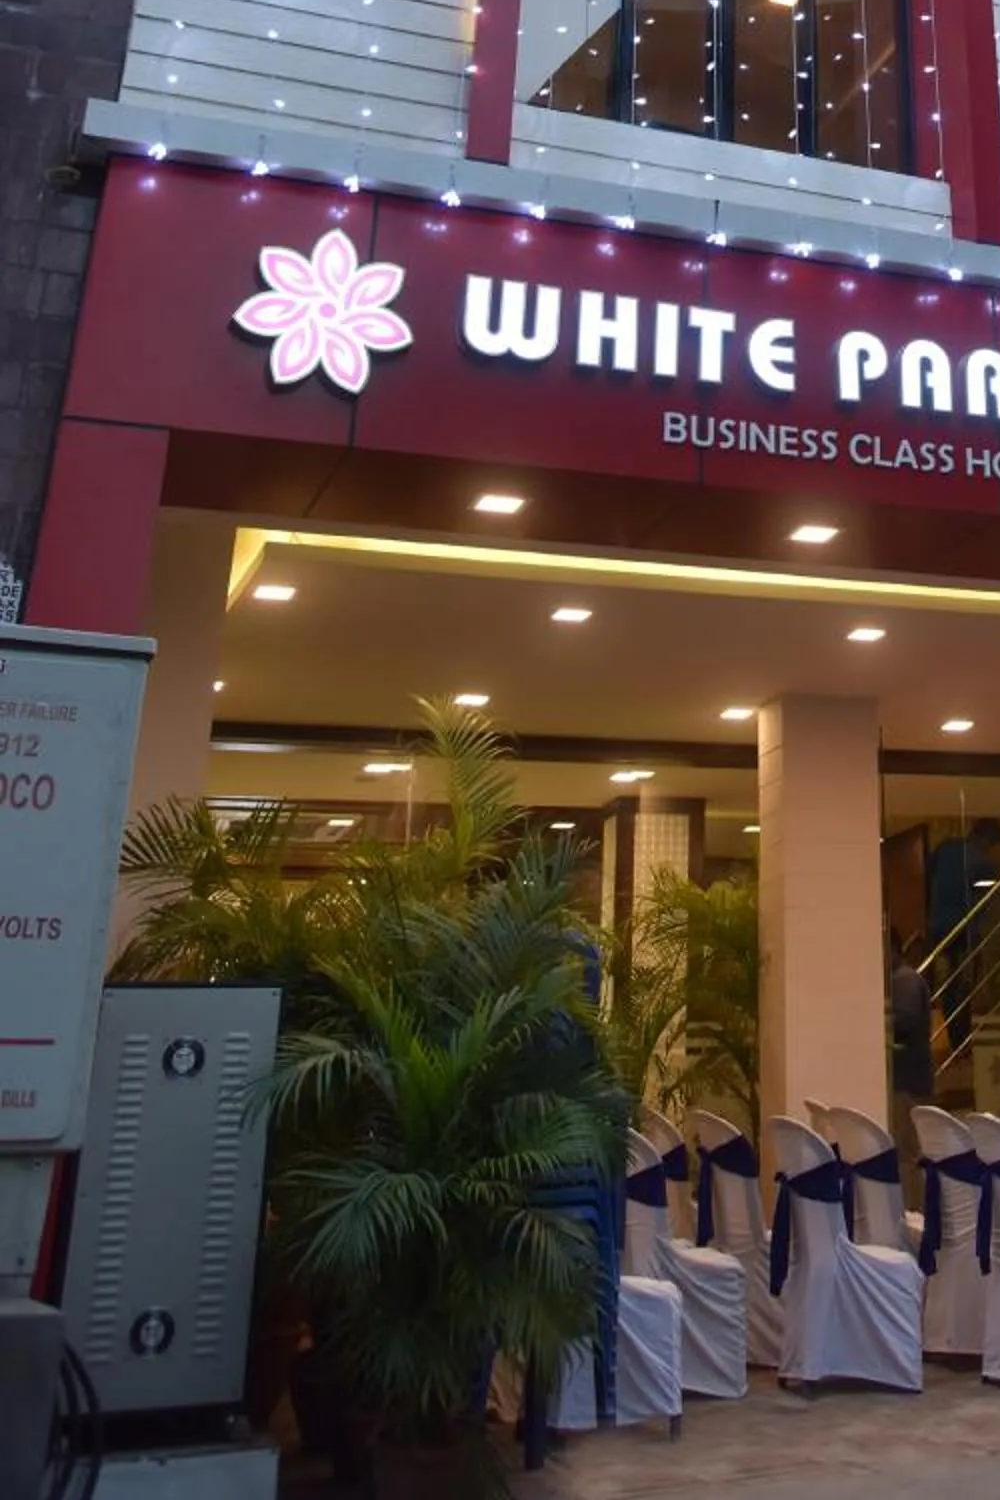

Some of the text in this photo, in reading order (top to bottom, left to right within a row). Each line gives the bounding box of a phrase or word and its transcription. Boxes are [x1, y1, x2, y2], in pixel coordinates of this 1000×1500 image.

[464, 274, 794, 391] WHITE
[662, 411, 837, 460] BUSINESS
[848, 434, 954, 473] CLASS
[20, 702, 78, 722] FAILURE
